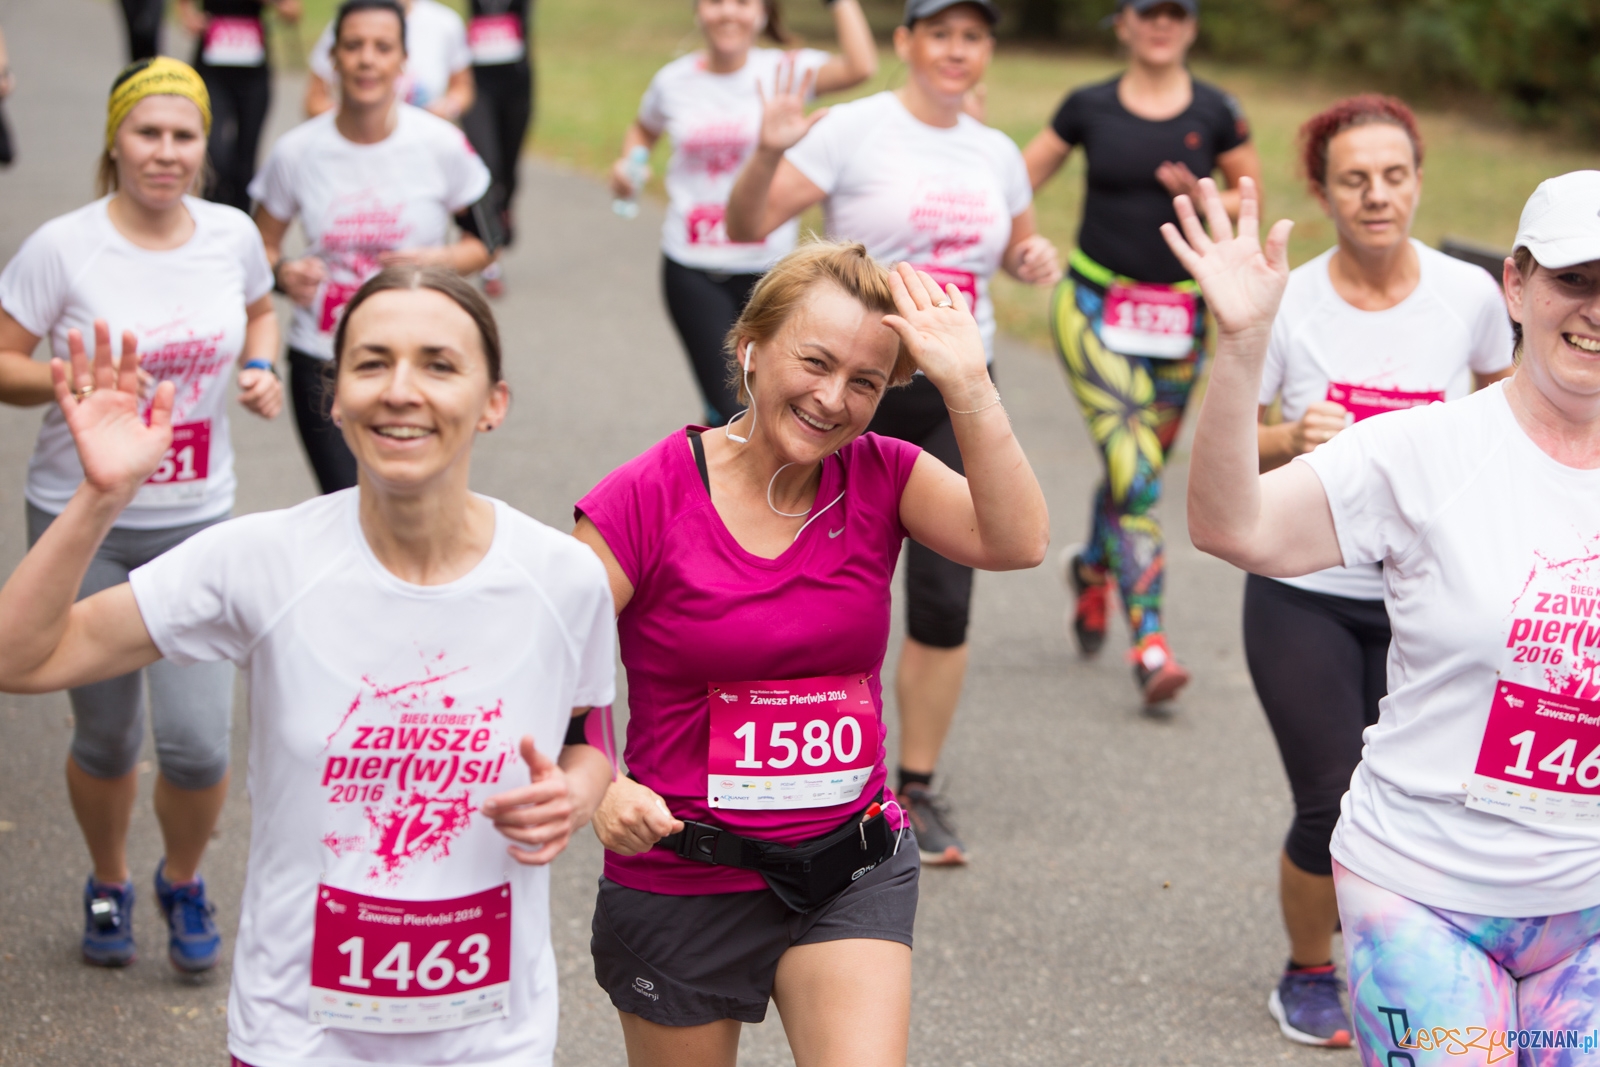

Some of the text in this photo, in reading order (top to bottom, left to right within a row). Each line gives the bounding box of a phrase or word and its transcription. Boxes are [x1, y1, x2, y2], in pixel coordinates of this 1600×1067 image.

[1571, 584, 1594, 597] BIEG
[1534, 591, 1600, 620] zaw
[1512, 645, 1564, 665] 2016
[750, 694, 788, 705] Zawsze
[789, 691, 827, 705] Pier(w)si
[827, 690, 847, 702] 2016
[400, 712, 477, 726] BIEG KOBIET
[1534, 704, 1576, 722] Zawsze
[351, 726, 490, 752] zawsze
[733, 715, 862, 769] 1580
[321, 752, 506, 793] pier(w)si!
[328, 784, 385, 803] 2016
[357, 907, 402, 925] Zawsze
[403, 912, 454, 927] Pier(w)si
[454, 906, 483, 922] 2016
[337, 932, 491, 991] 1463
